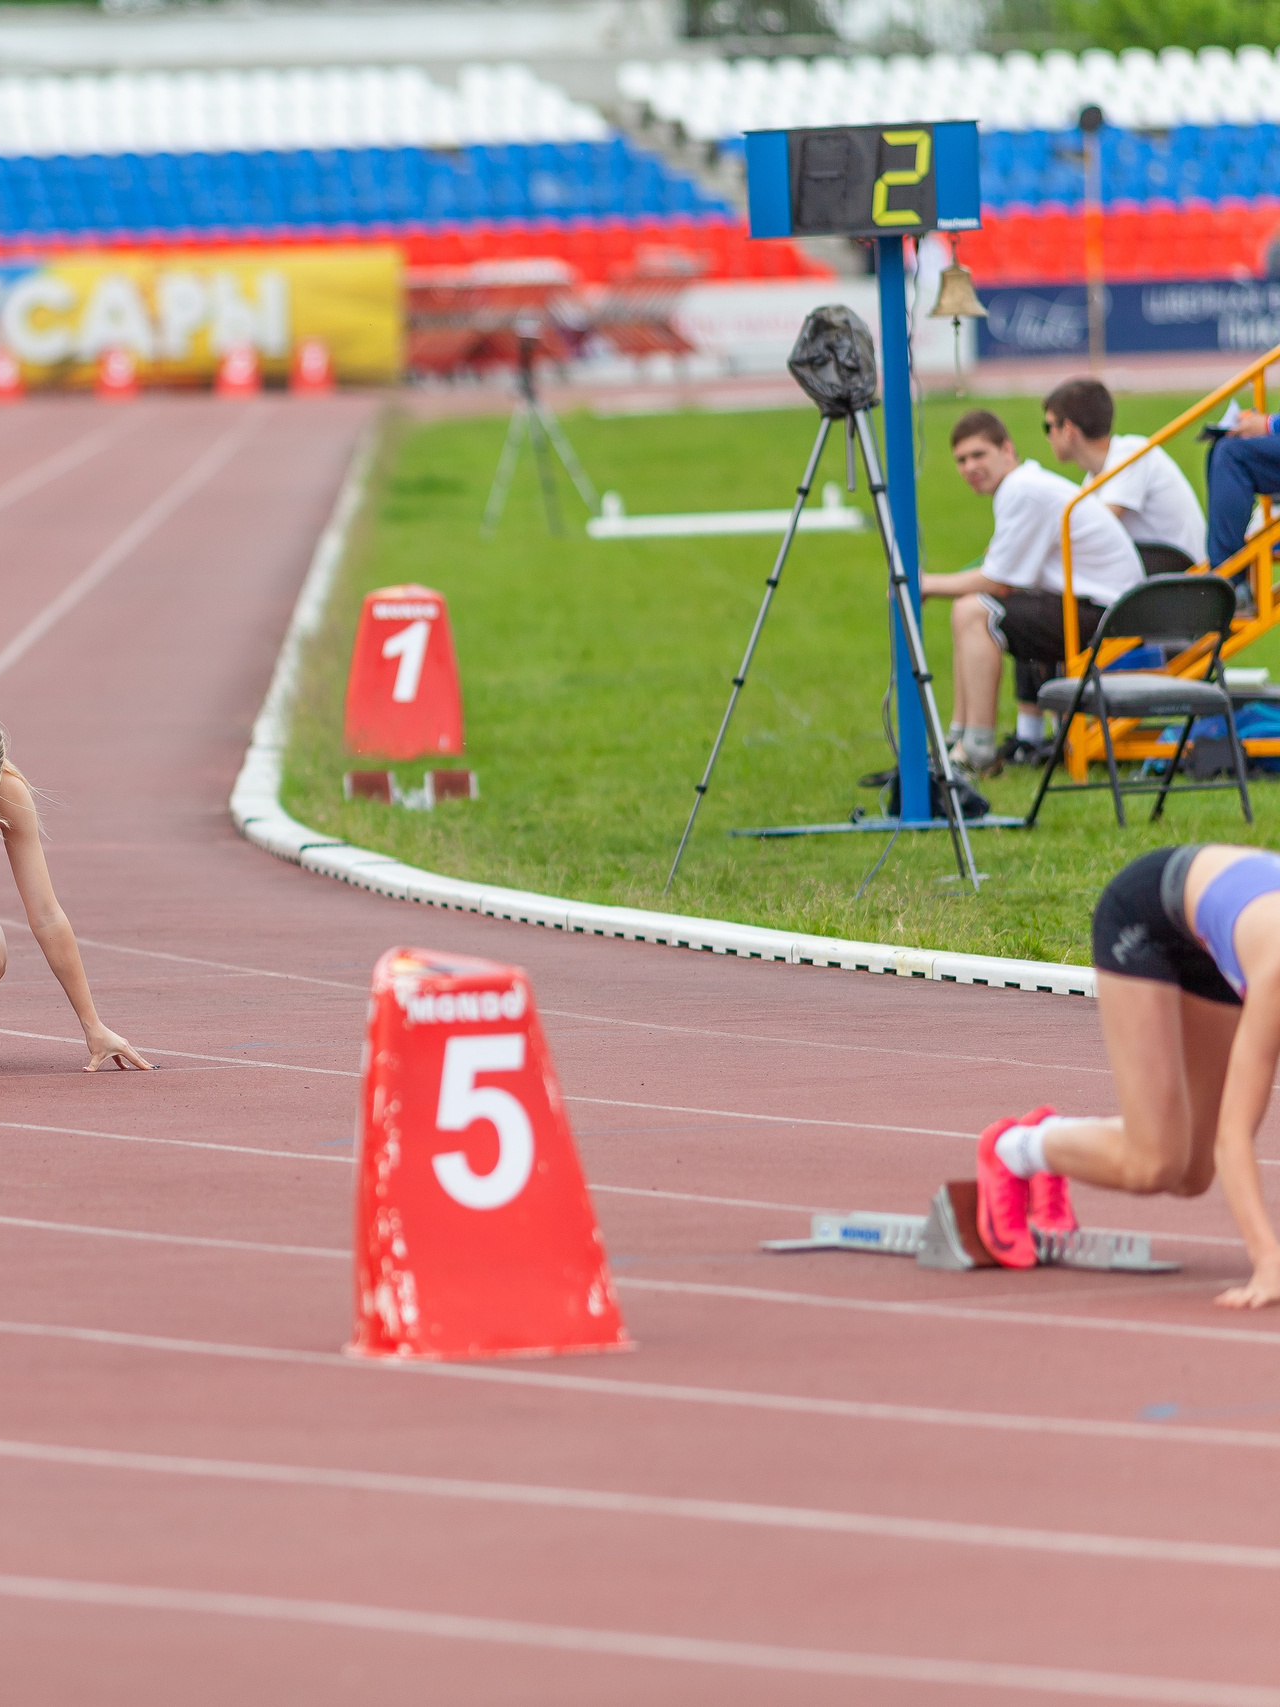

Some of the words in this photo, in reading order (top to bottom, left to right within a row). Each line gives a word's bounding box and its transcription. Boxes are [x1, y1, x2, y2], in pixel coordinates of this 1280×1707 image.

[872, 129, 932, 227] 2
[381, 619, 431, 703] 1
[406, 990, 524, 1023] MONDO
[431, 1032, 535, 1211] 5
